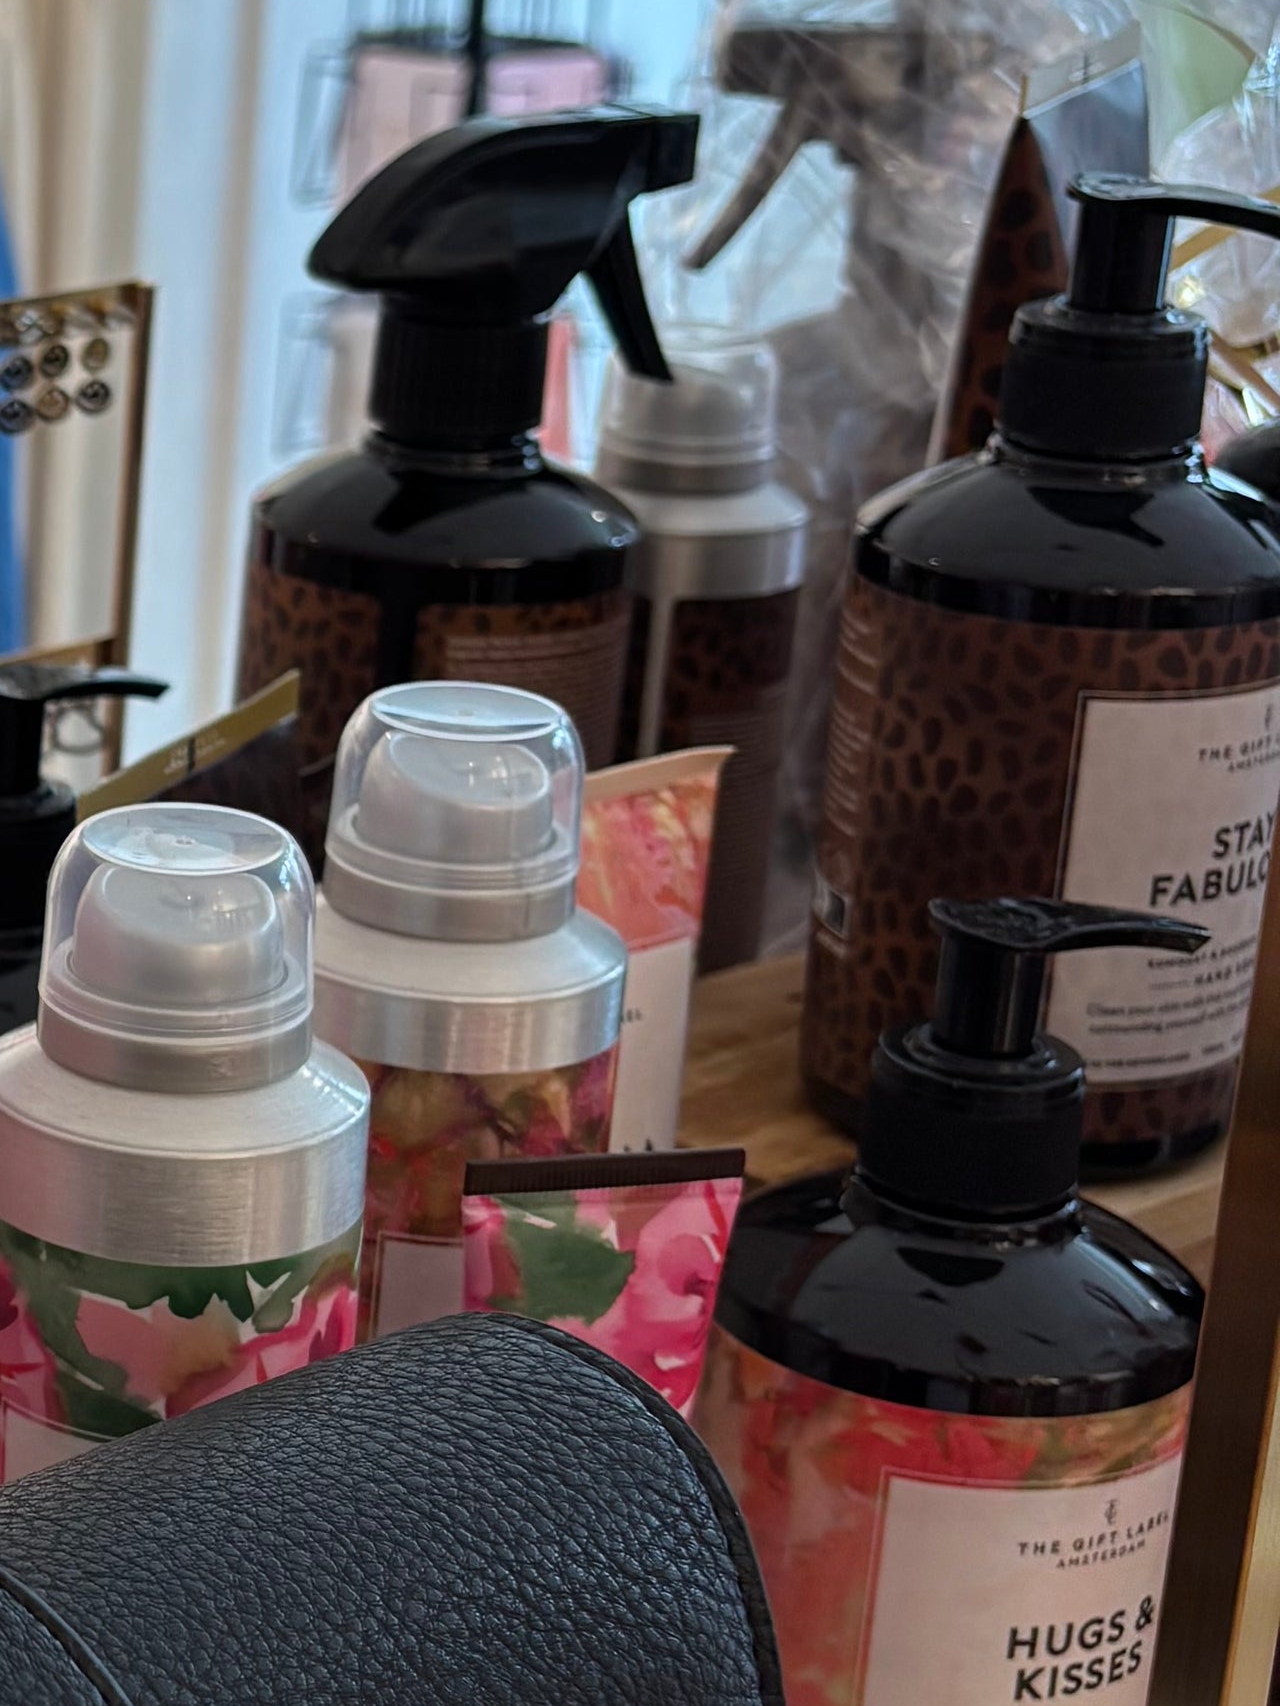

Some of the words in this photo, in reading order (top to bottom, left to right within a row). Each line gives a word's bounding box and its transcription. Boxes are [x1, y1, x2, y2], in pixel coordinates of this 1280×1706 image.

[1018, 1539, 1062, 1557] THE
[1072, 1529, 1119, 1554] GIFT
[1006, 1608, 1126, 1660] HUGS
[1134, 1594, 1155, 1631] &
[1013, 1640, 1144, 1702] KISSES
